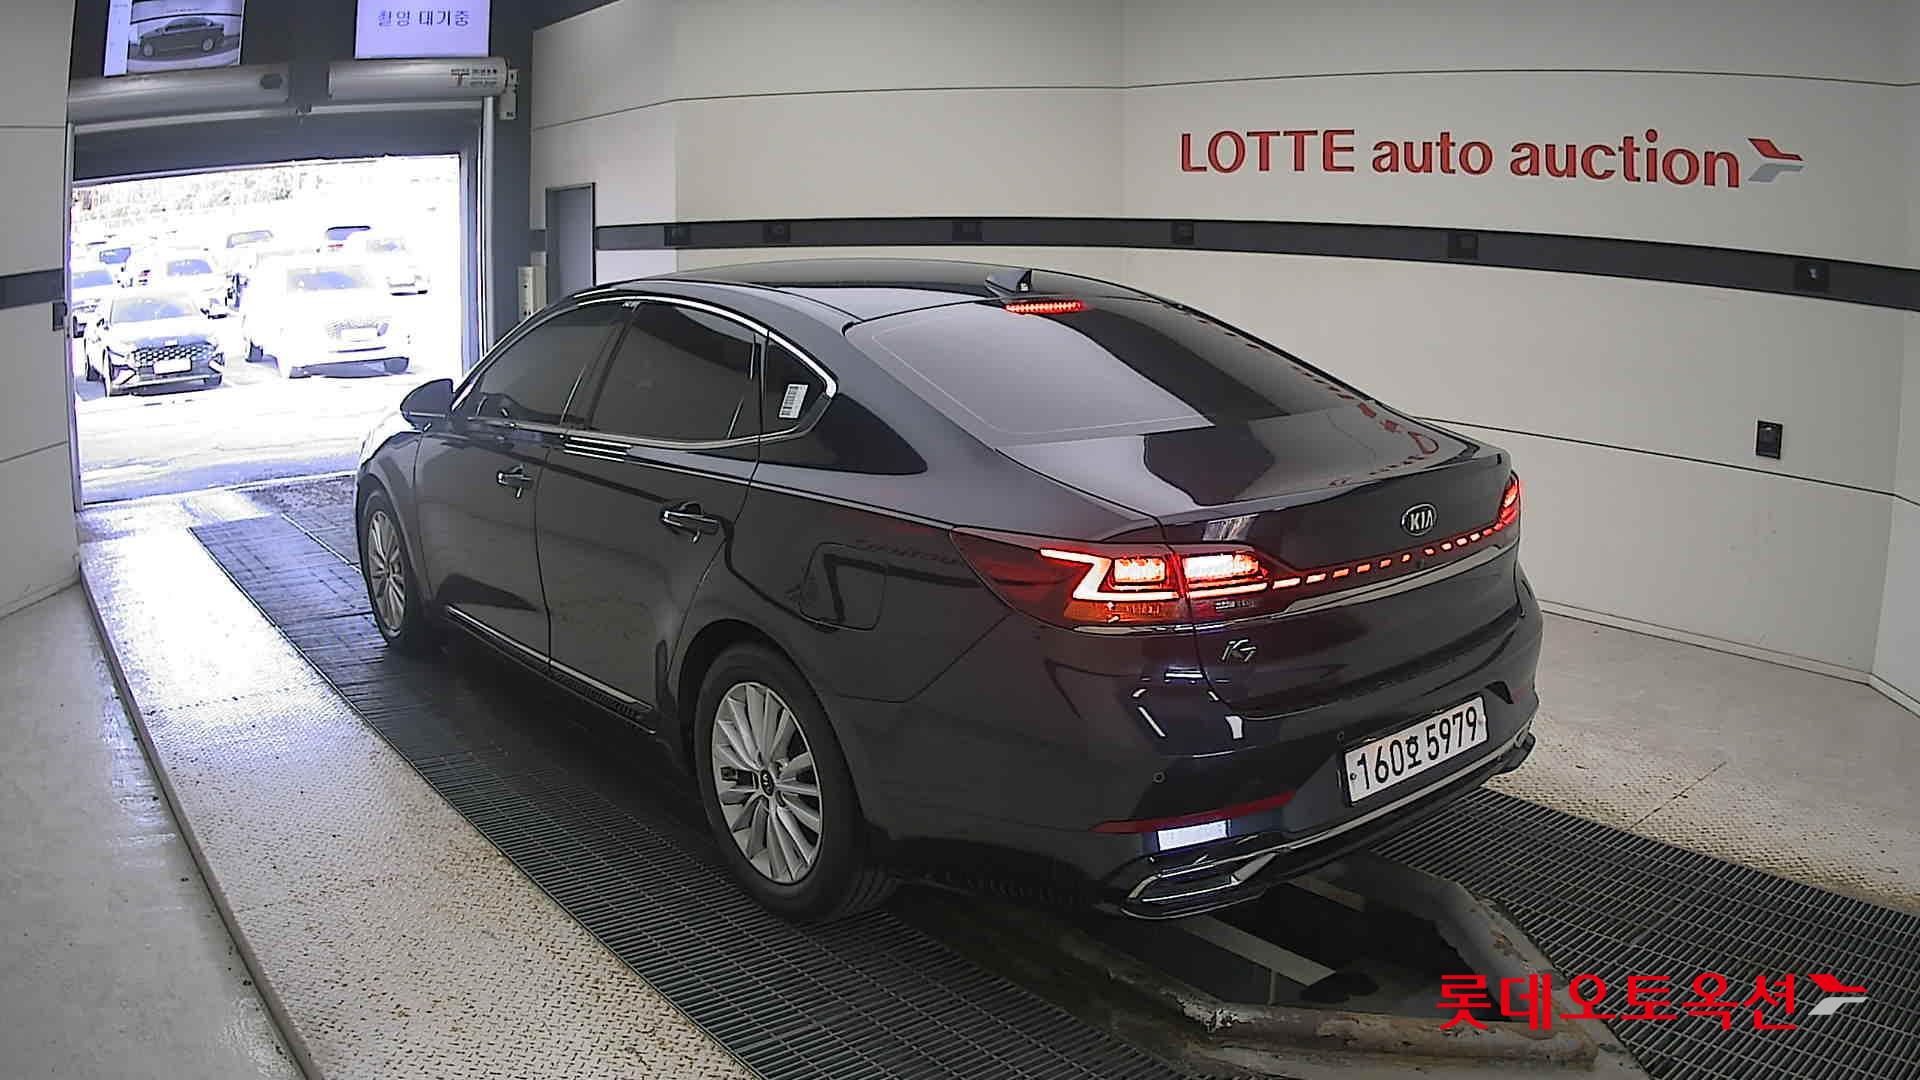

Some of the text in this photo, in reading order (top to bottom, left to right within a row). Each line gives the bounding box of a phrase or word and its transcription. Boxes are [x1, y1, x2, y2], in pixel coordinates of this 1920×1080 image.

[419, 9, 470, 27] 대기중
[1181, 129, 1740, 188] LOTTE auto auction
[1408, 508, 1434, 532] KIA
[1425, 706, 1478, 761] 5979
